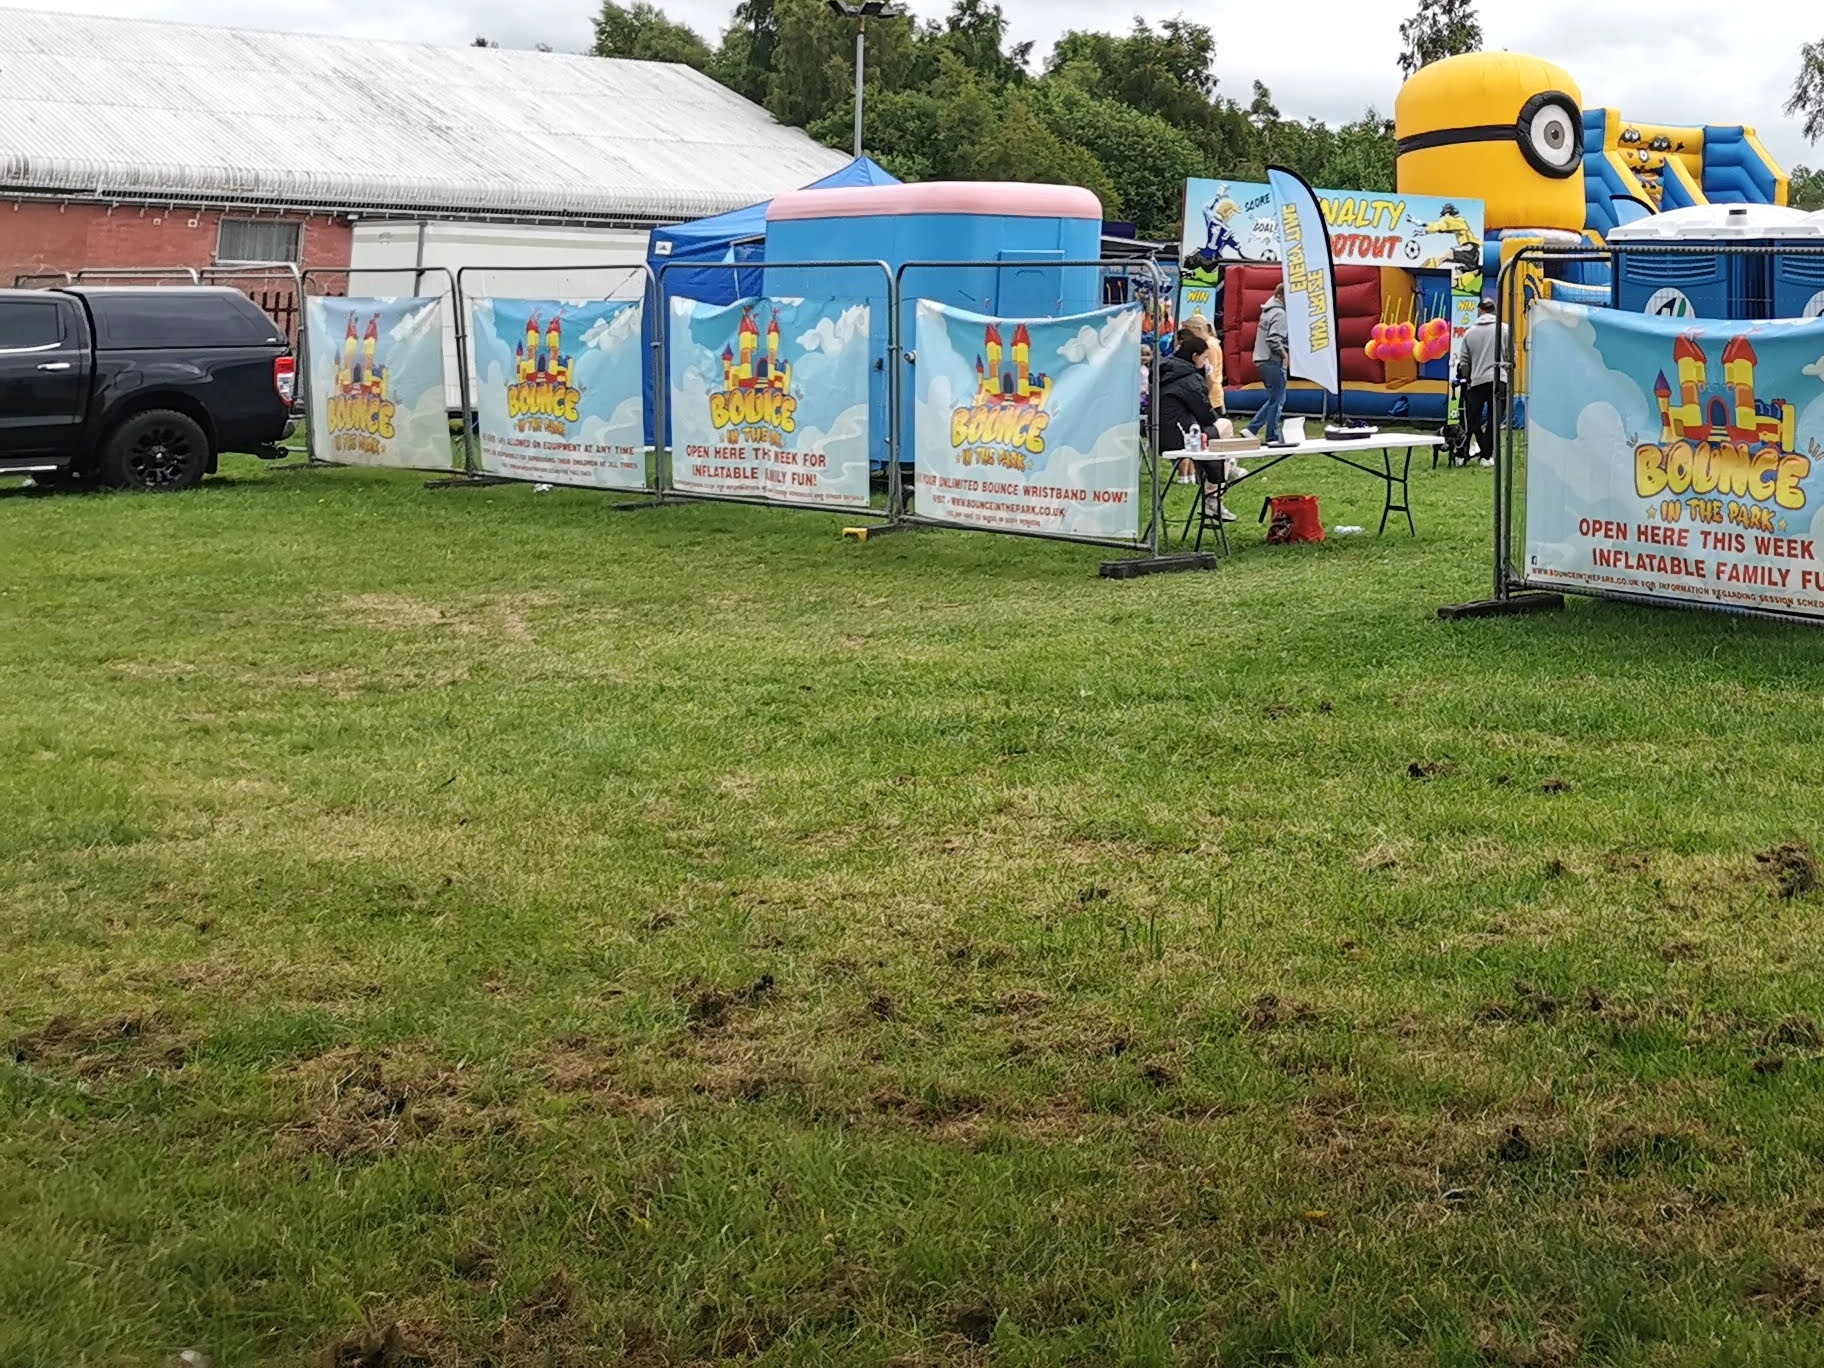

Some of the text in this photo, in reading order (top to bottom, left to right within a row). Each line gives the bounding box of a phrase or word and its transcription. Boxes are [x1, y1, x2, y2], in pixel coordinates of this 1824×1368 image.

[1244, 193, 1271, 212] SCORE
[1319, 197, 1406, 231] NALTY
[1330, 233, 1403, 259] OTOUT
[1187, 290, 1209, 303] WIN
[1457, 300, 1475, 311] WIN
[951, 405, 1050, 454] BOUNCE
[615, 446, 634, 455] TIME
[686, 445, 710, 459] OPEN
[714, 446, 746, 460] HERE
[803, 453, 826, 467] FOR
[692, 464, 759, 480] INFLATABLE
[792, 472, 817, 487] FUN!
[1634, 439, 1812, 510] BOUNCE
[939, 477, 979, 492] UNLIMITED
[982, 481, 1018, 496] BOUNCE
[1023, 485, 1087, 501] WRISTBAND
[1093, 490, 1129, 504] NOW!
[1660, 497, 1776, 533] IN THE PARK
[1579, 518, 1628, 541] OPEN
[1637, 524, 1690, 548] HERE
[1700, 530, 1746, 553] THIS
[1755, 535, 1815, 561] WEEK
[1592, 547, 1706, 579] INFLATABLE
[1715, 561, 1791, 588] FAMILY
[1659, 581, 1709, 596] INFORMATION
[1712, 588, 1756, 601] REGARDING
[1759, 593, 1793, 605] SESSION
